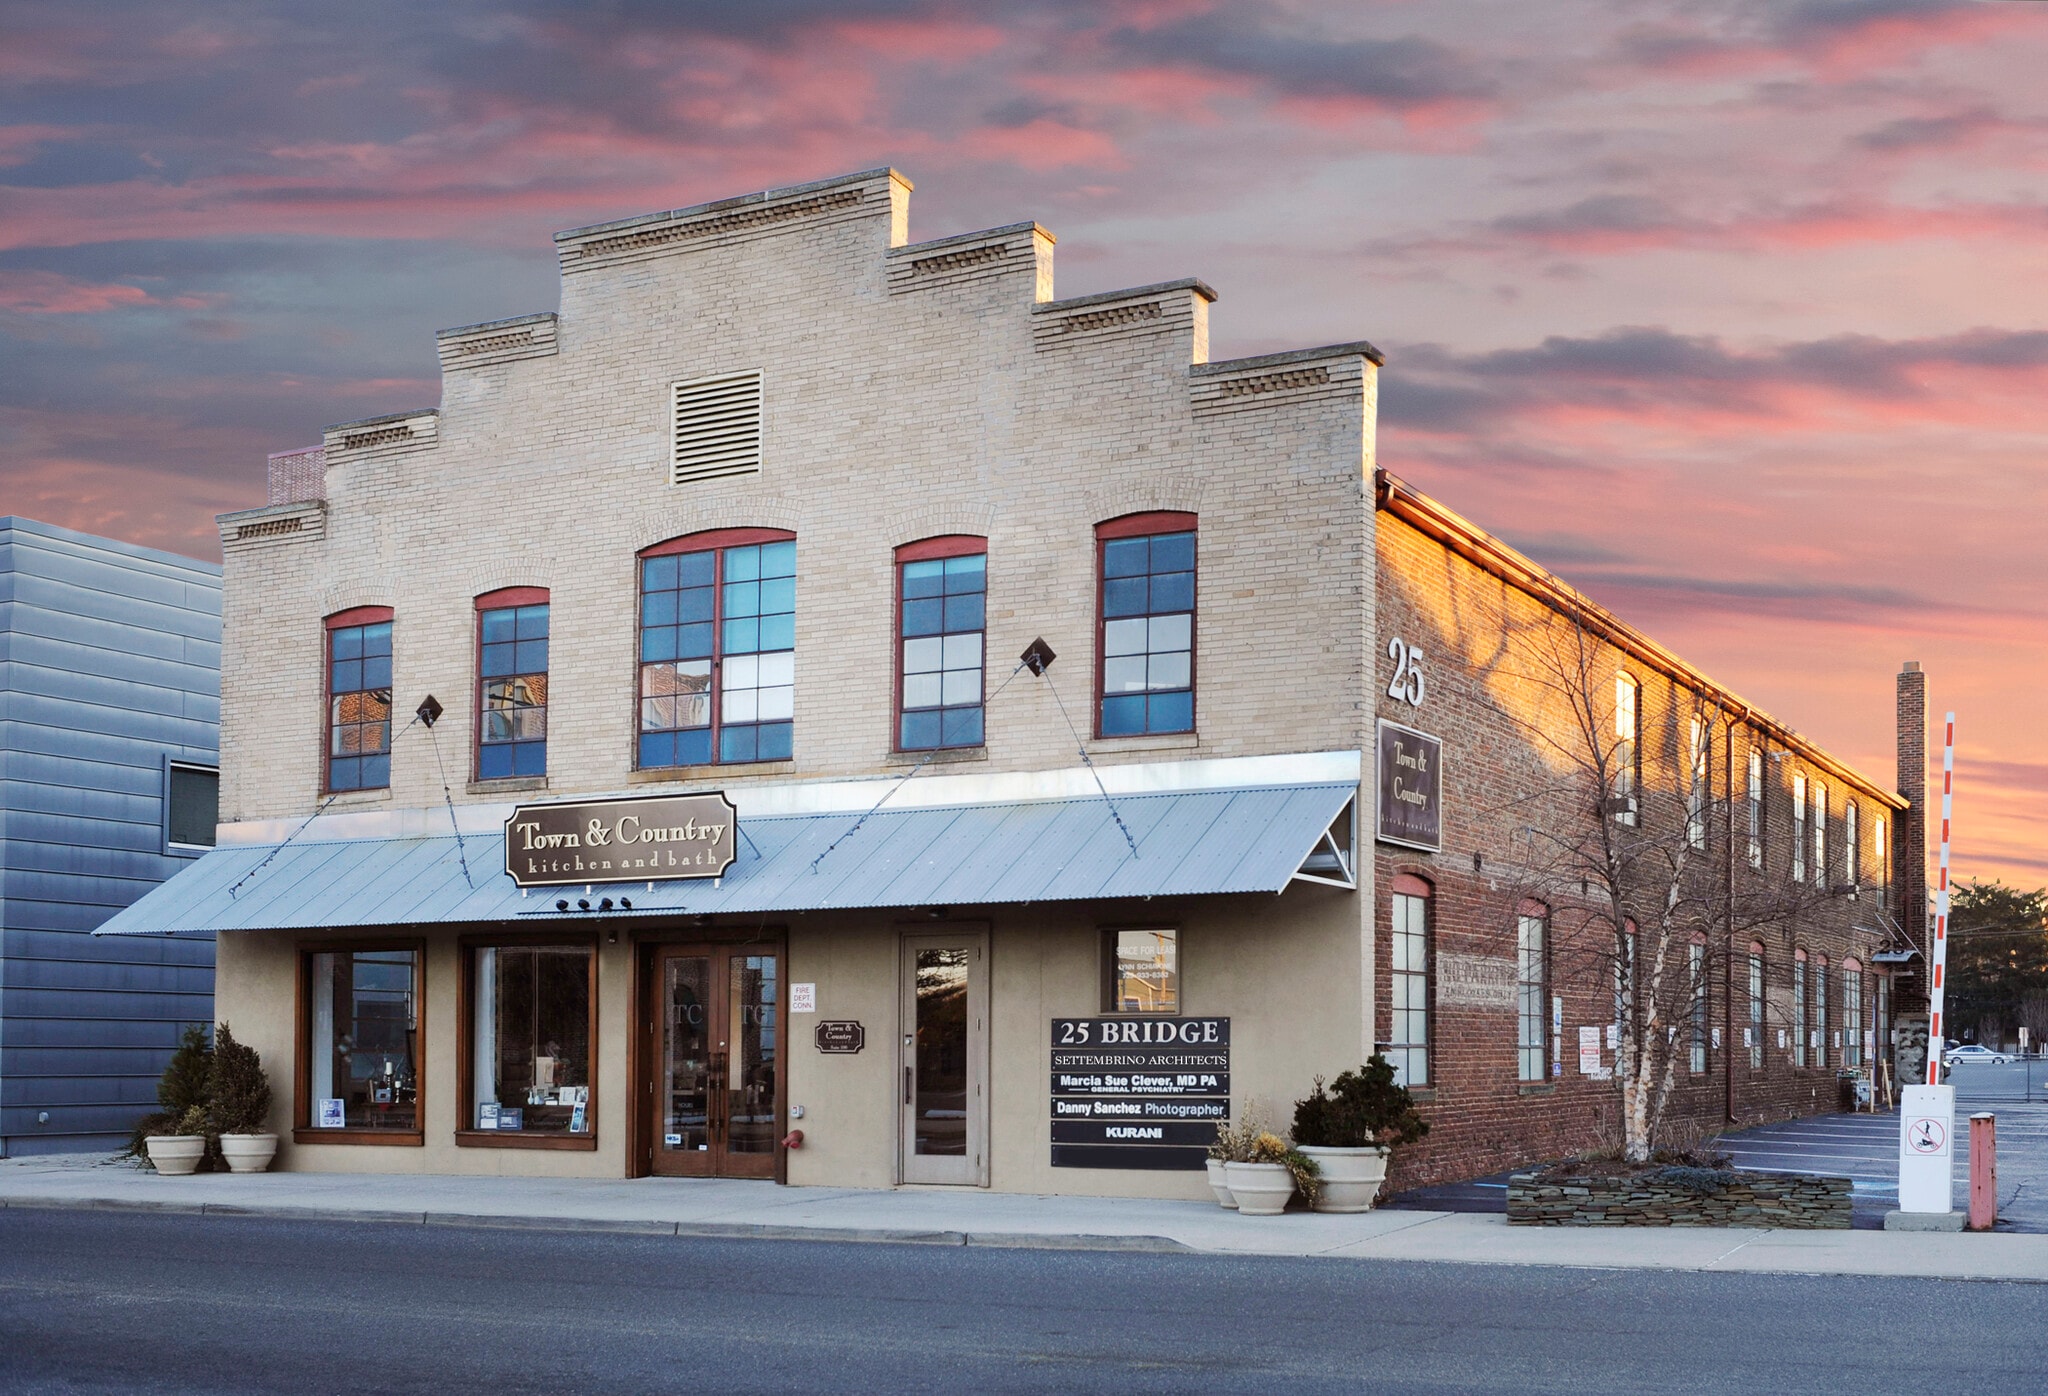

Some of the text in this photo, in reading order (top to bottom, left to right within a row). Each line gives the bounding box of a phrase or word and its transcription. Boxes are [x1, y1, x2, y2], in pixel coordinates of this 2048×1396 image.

[1388, 637, 1425, 707] 25
[1394, 741, 1427, 772] Town &
[1394, 776, 1427, 811] Country
[516, 816, 727, 850] Town & Country
[528, 849, 717, 874] kitchen and bath
[796, 986, 810, 994] FIRE
[1060, 1021, 1219, 1044] 25 BRIDGE
[1055, 1055, 1227, 1066] SETTEMBRINO ARCHITECTS
[1060, 1074, 1218, 1088] Marcia Sue Clever, MD PA
[1057, 1101, 1224, 1117] Danny Sanchez Photographer
[1105, 1127, 1163, 1139] KURANI
